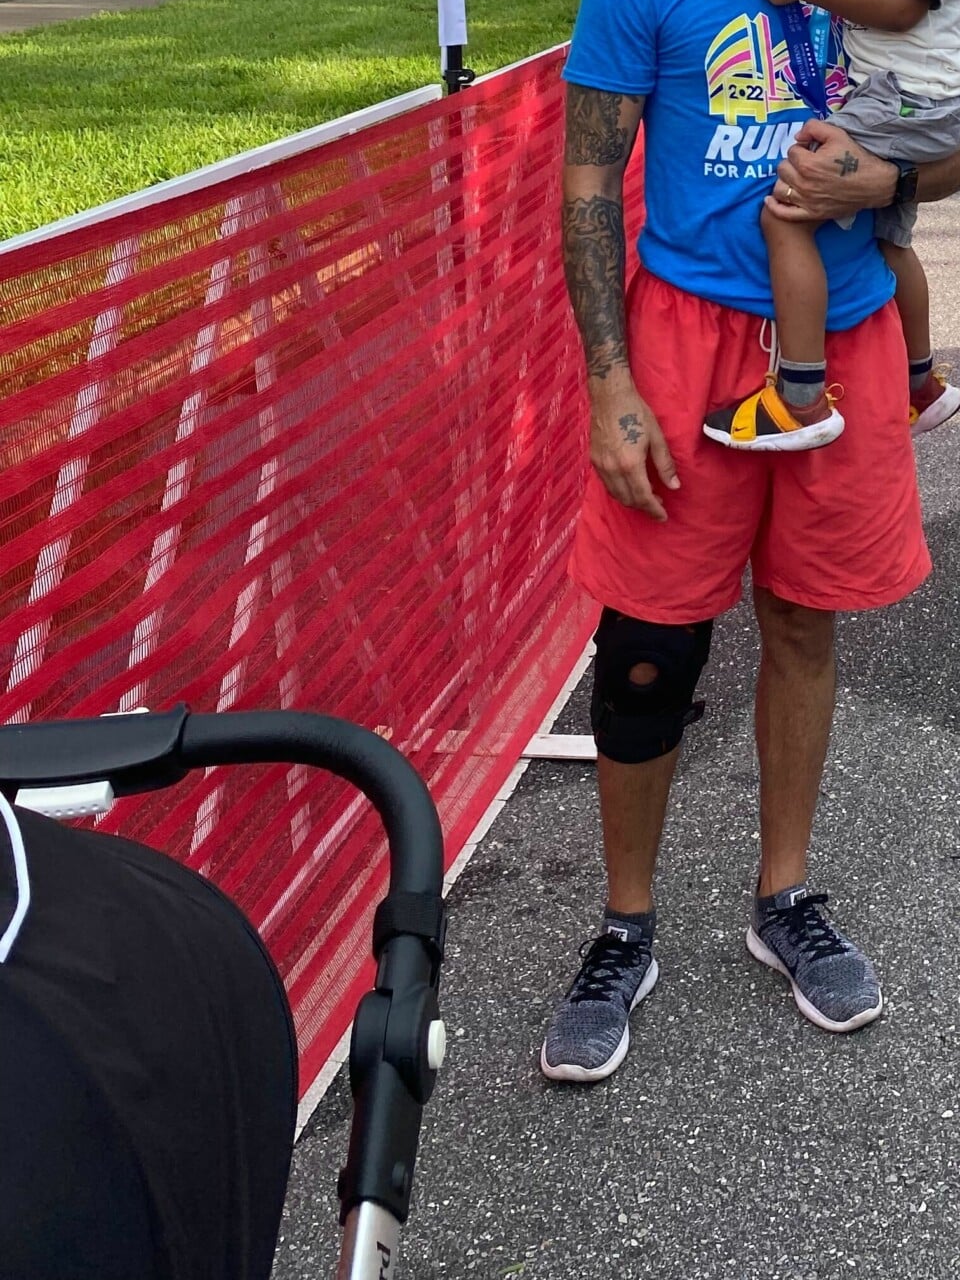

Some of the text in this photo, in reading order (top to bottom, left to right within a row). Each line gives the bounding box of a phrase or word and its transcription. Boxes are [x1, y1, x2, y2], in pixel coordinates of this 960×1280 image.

[704, 121, 804, 162] RUN
[703, 162, 777, 179] FOR ALL
